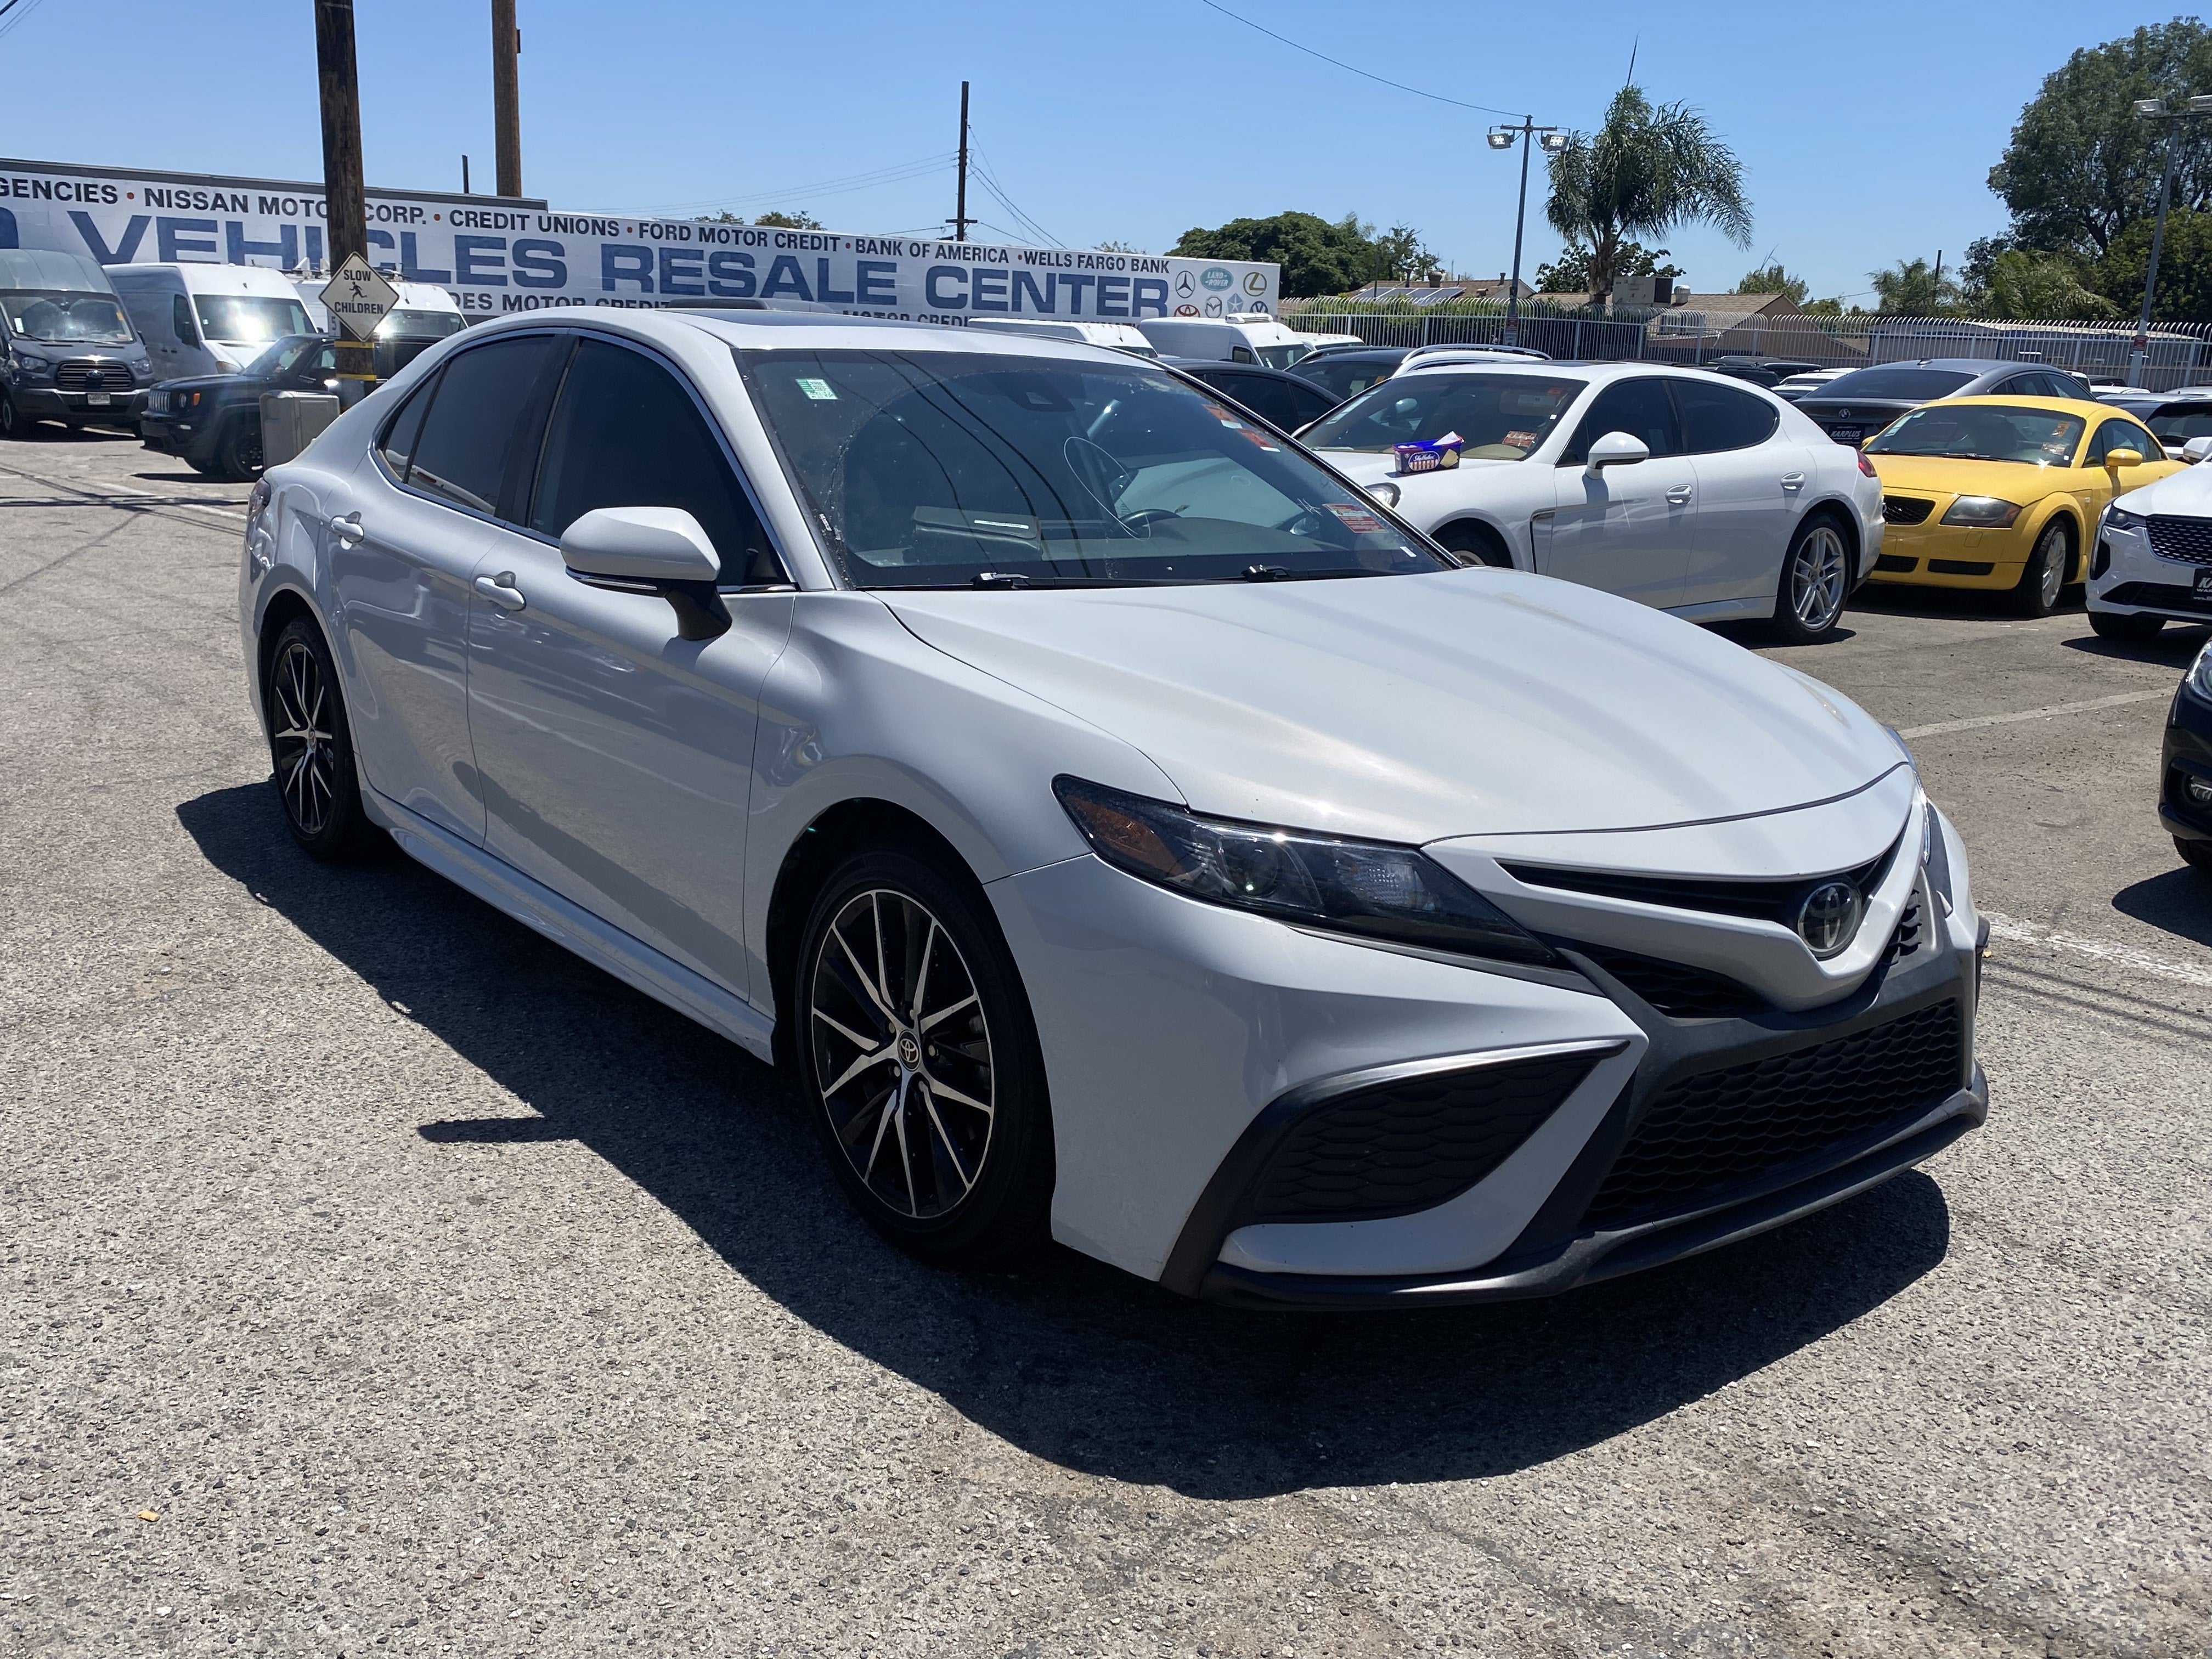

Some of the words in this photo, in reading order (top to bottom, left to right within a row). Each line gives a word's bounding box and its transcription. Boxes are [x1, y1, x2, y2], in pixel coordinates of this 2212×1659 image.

[144, 188, 249, 213] NISSAN
[258, 195, 328, 219] MOTO
[449, 209, 530, 231] CREDIT
[538, 215, 620, 237] UNIONS
[639, 222, 691, 241] FORD
[698, 227, 768, 247] MOTOR
[775, 232, 840, 252] CREDIT
[855, 238, 903, 257] BANK
[910, 242, 930, 258] OF
[935, 244, 1009, 264] AMERICA
[1024, 250, 1072, 268] WELLS
[1077, 254, 1125, 271] FARGO
[1131, 258, 1170, 274] BANK
[343, 269, 371, 281] SLOW
[601, 243, 897, 306] RESALE
[926, 265, 1169, 318] CENTER
[334, 302, 383, 314] CHILDREN
[331, 316, 336, 331] 5
